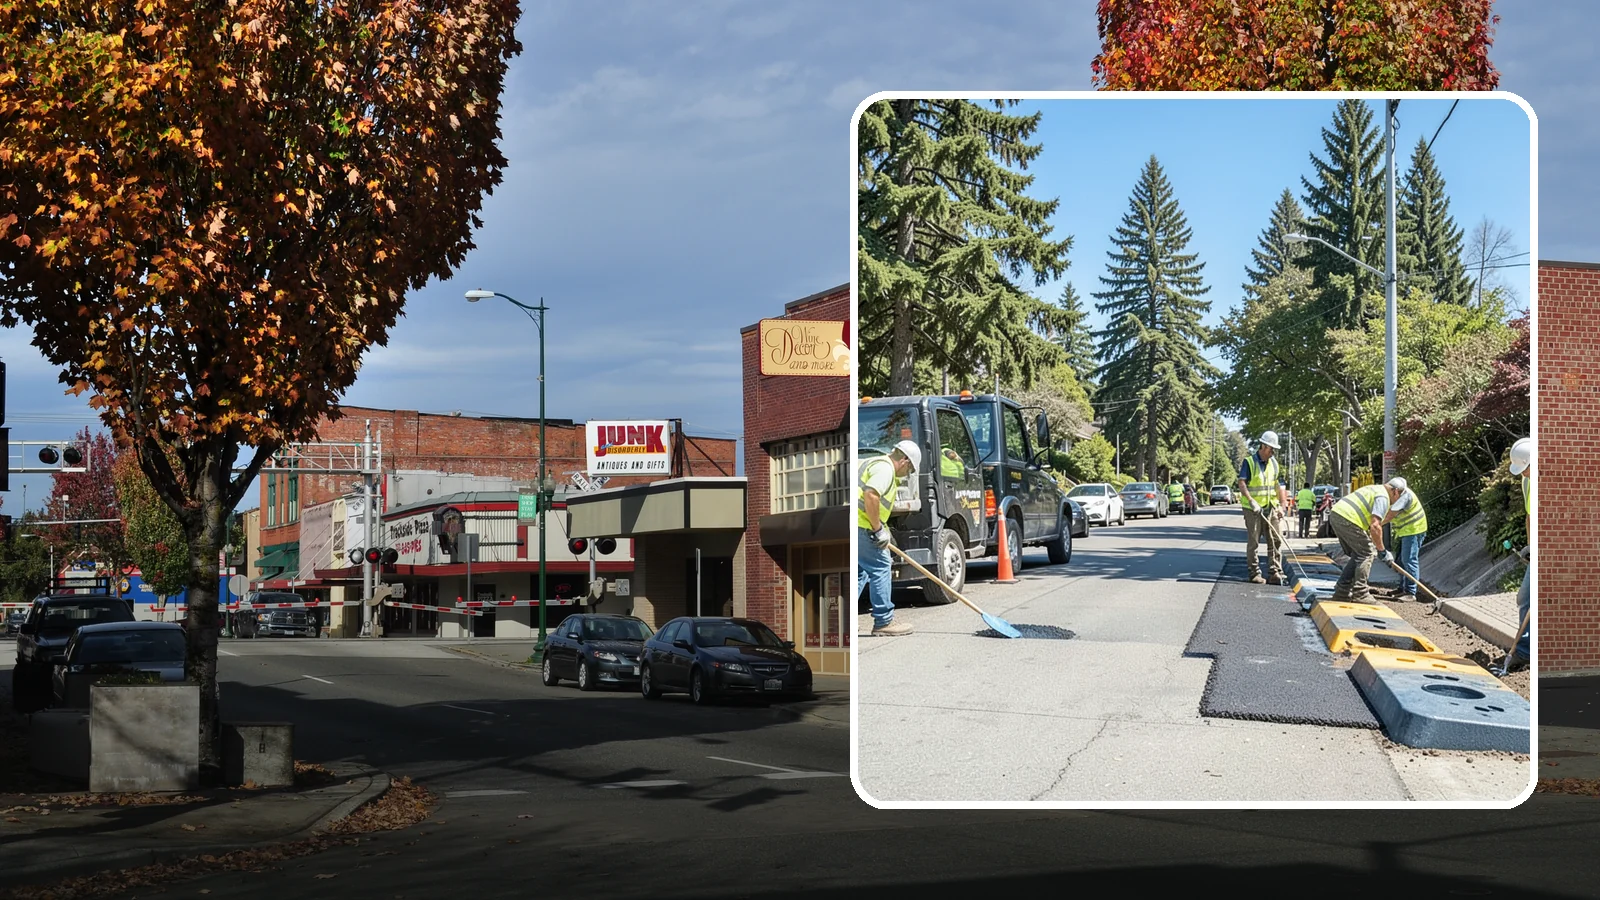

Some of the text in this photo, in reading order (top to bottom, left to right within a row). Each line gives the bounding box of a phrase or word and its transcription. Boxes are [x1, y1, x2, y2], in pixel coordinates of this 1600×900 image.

[596, 425, 665, 457] JUNK
[597, 460, 665, 470] ANTIQUES AND GIFTS
[589, 476, 608, 492] SING
[352, 498, 365, 511] CRO
[390, 519, 429, 540] Trackside Pizza
